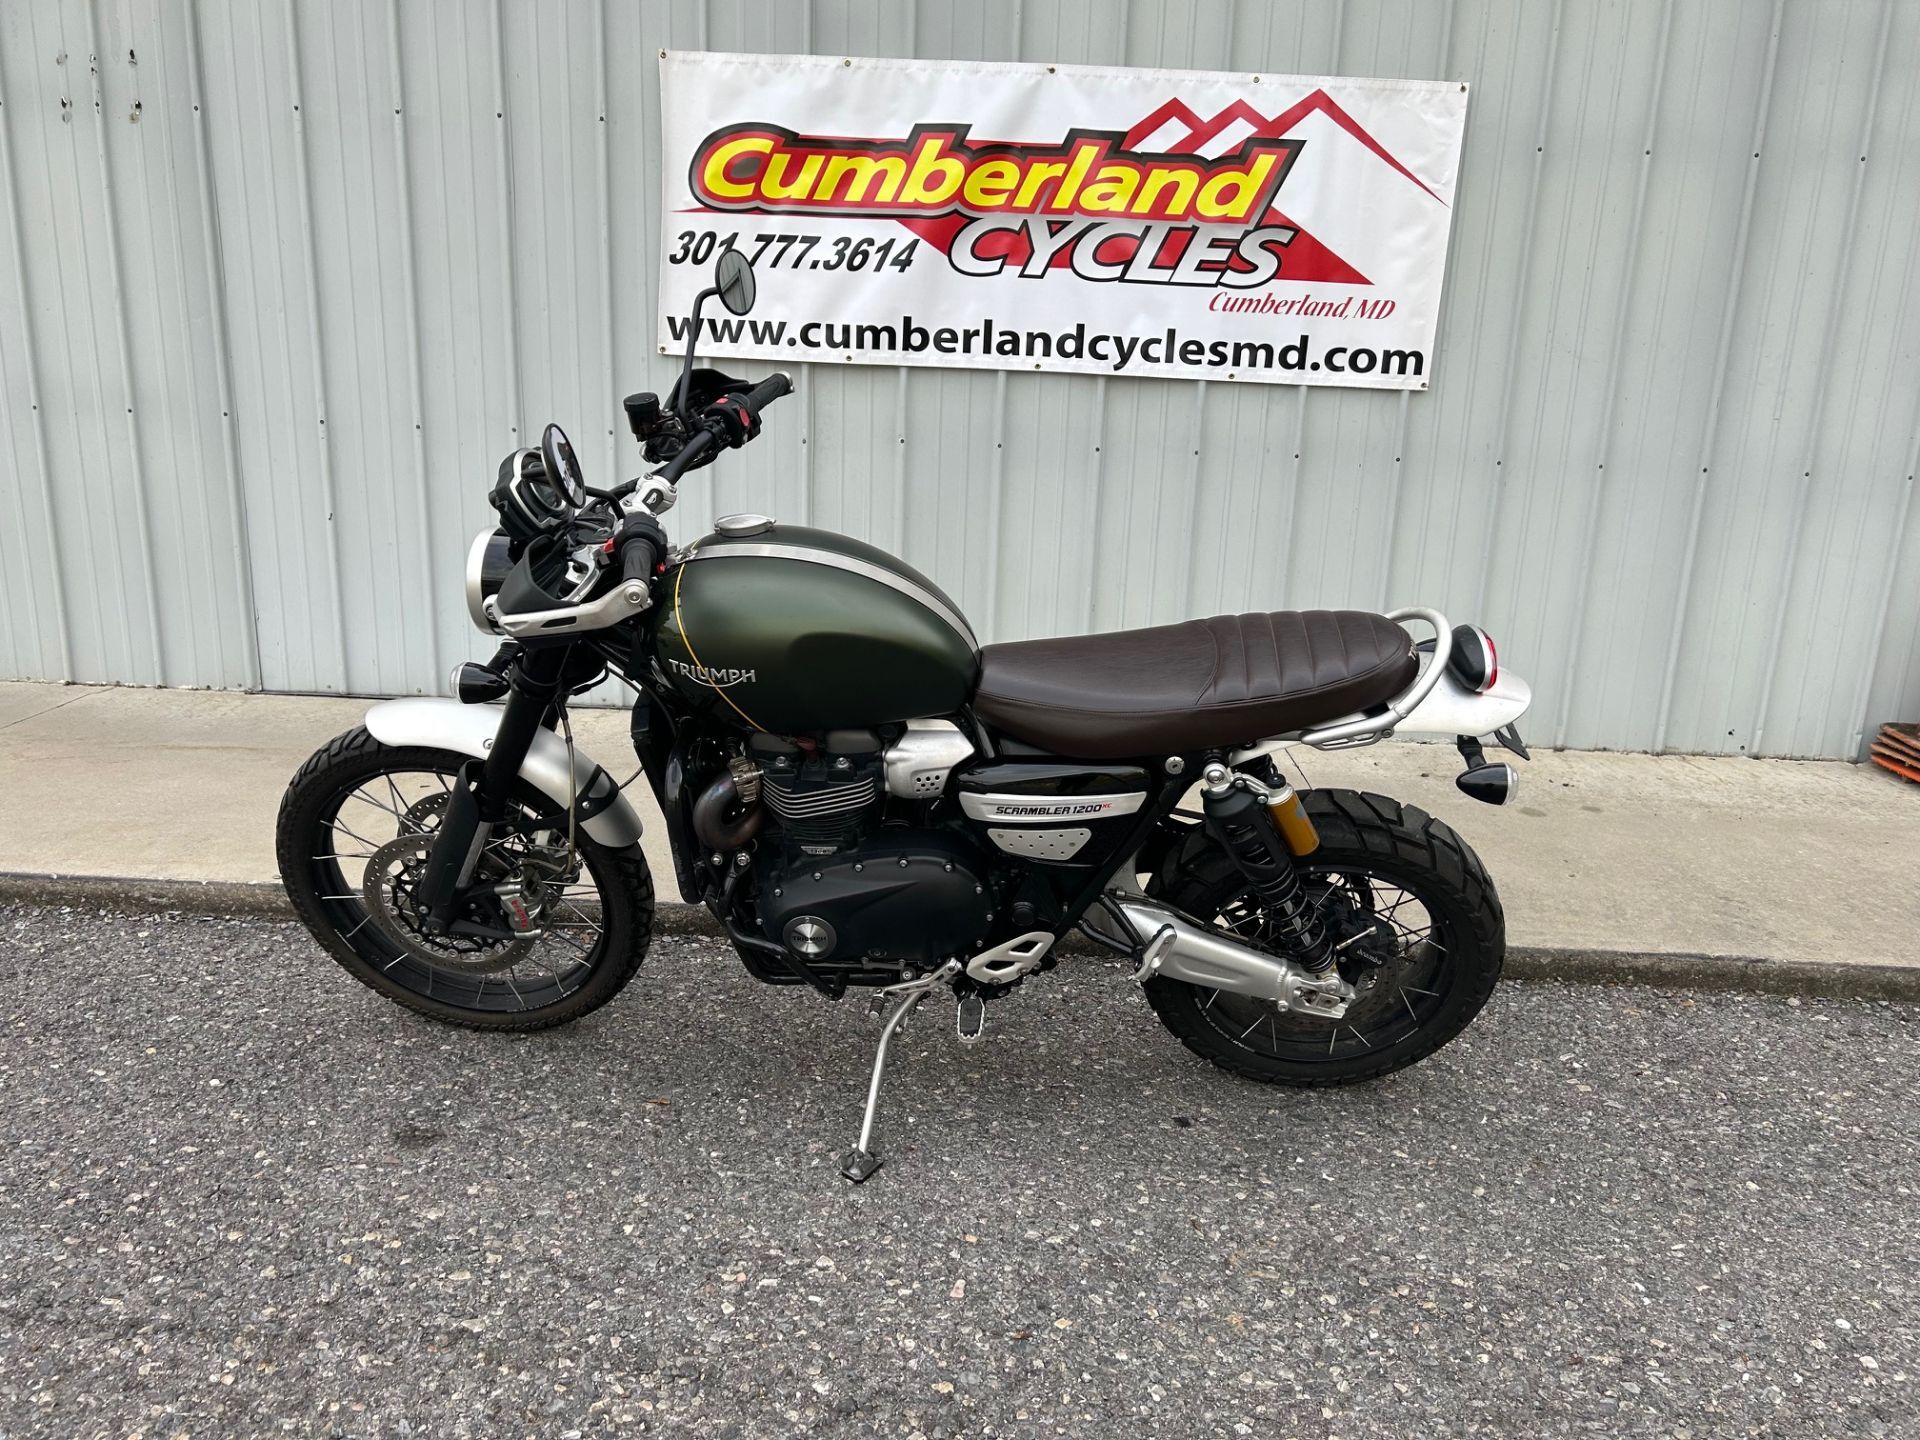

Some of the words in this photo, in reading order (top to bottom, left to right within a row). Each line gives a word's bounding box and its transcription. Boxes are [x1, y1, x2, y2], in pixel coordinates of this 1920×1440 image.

[701, 135, 1280, 220] Cumberland
[669, 230, 921, 273] 301777.3614
[948, 214, 1300, 288] CYCLES
[1208, 291, 1350, 319] Cumberland,
[1353, 300, 1396, 319] MD
[667, 315, 1424, 376] www.cumberlandcyclesmd.com
[668, 659, 756, 687] TRIUMPH
[995, 806, 1071, 815] SCRAMBLER
